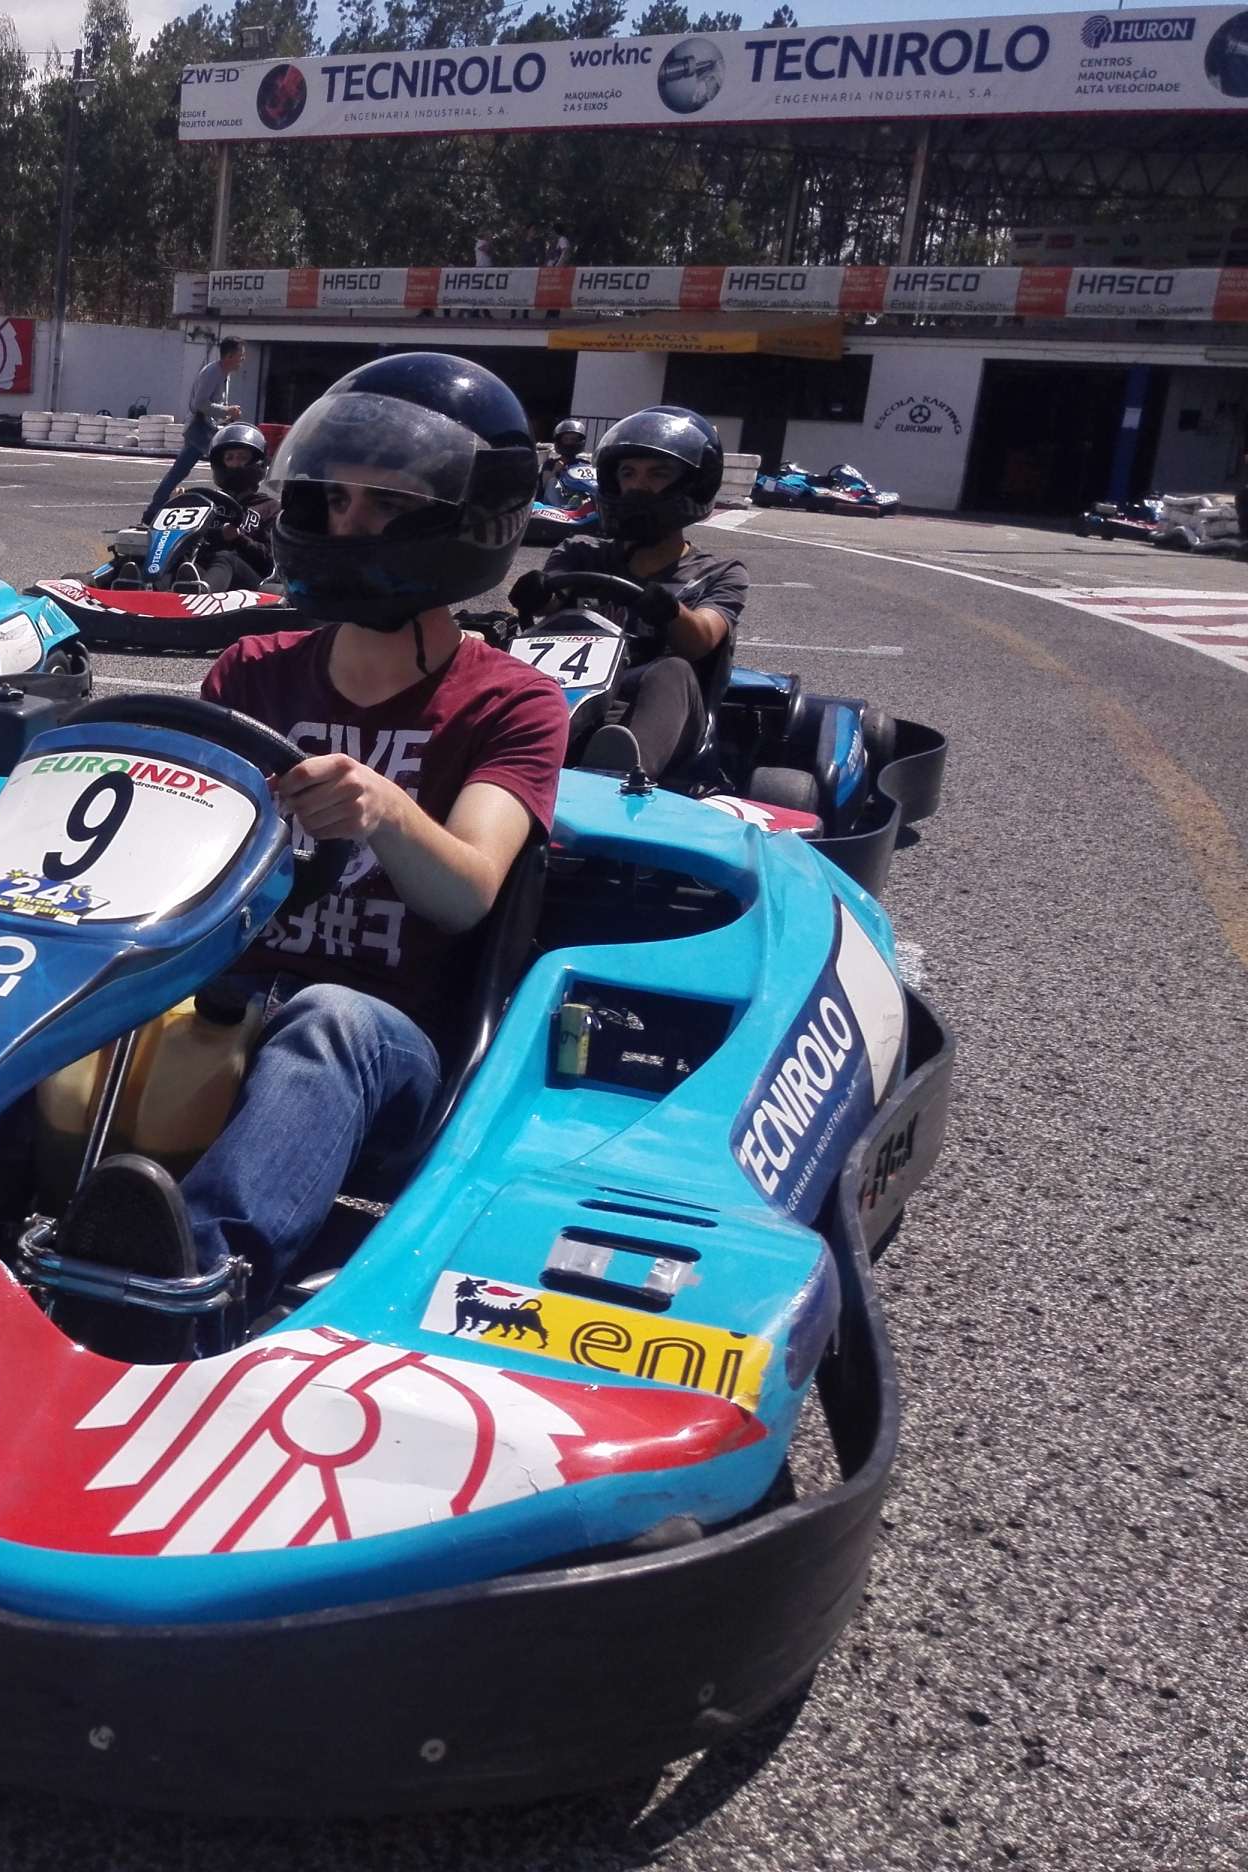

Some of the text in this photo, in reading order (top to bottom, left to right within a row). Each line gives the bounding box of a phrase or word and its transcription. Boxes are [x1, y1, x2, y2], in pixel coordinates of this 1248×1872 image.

[1119, 21, 1188, 40] HURON
[570, 42, 653, 68] worknc
[744, 24, 1050, 83] TECNIROLO
[1079, 57, 1133, 68] CENTROS
[321, 52, 547, 103] TECNIROLO
[774, 91, 862, 104] ENGENHARIA
[1075, 82, 1181, 94] ALTA VELOCIDADE
[180, 120, 207, 128] ROJETO
[344, 110, 410, 122] ENGENHARIA
[212, 275, 264, 291] HASCO
[322, 274, 381, 290] HASCO
[444, 273, 508, 290] HASCO
[579, 273, 651, 290] HASCO
[728, 273, 807, 291] HASCO
[892, 272, 981, 293] HASCO
[1076, 274, 1174, 295] HASCO
[874, 396, 915, 430] ESCOLA
[163, 509, 200, 527] 63
[529, 642, 593, 680] 74
[32, 756, 222, 797] EUROINDY
[166, 788, 178, 796] da
[179, 791, 215, 809] Batalha
[42, 771, 134, 880] 9
[0, 877, 72, 906] 24
[570, 1319, 749, 1400] eni
